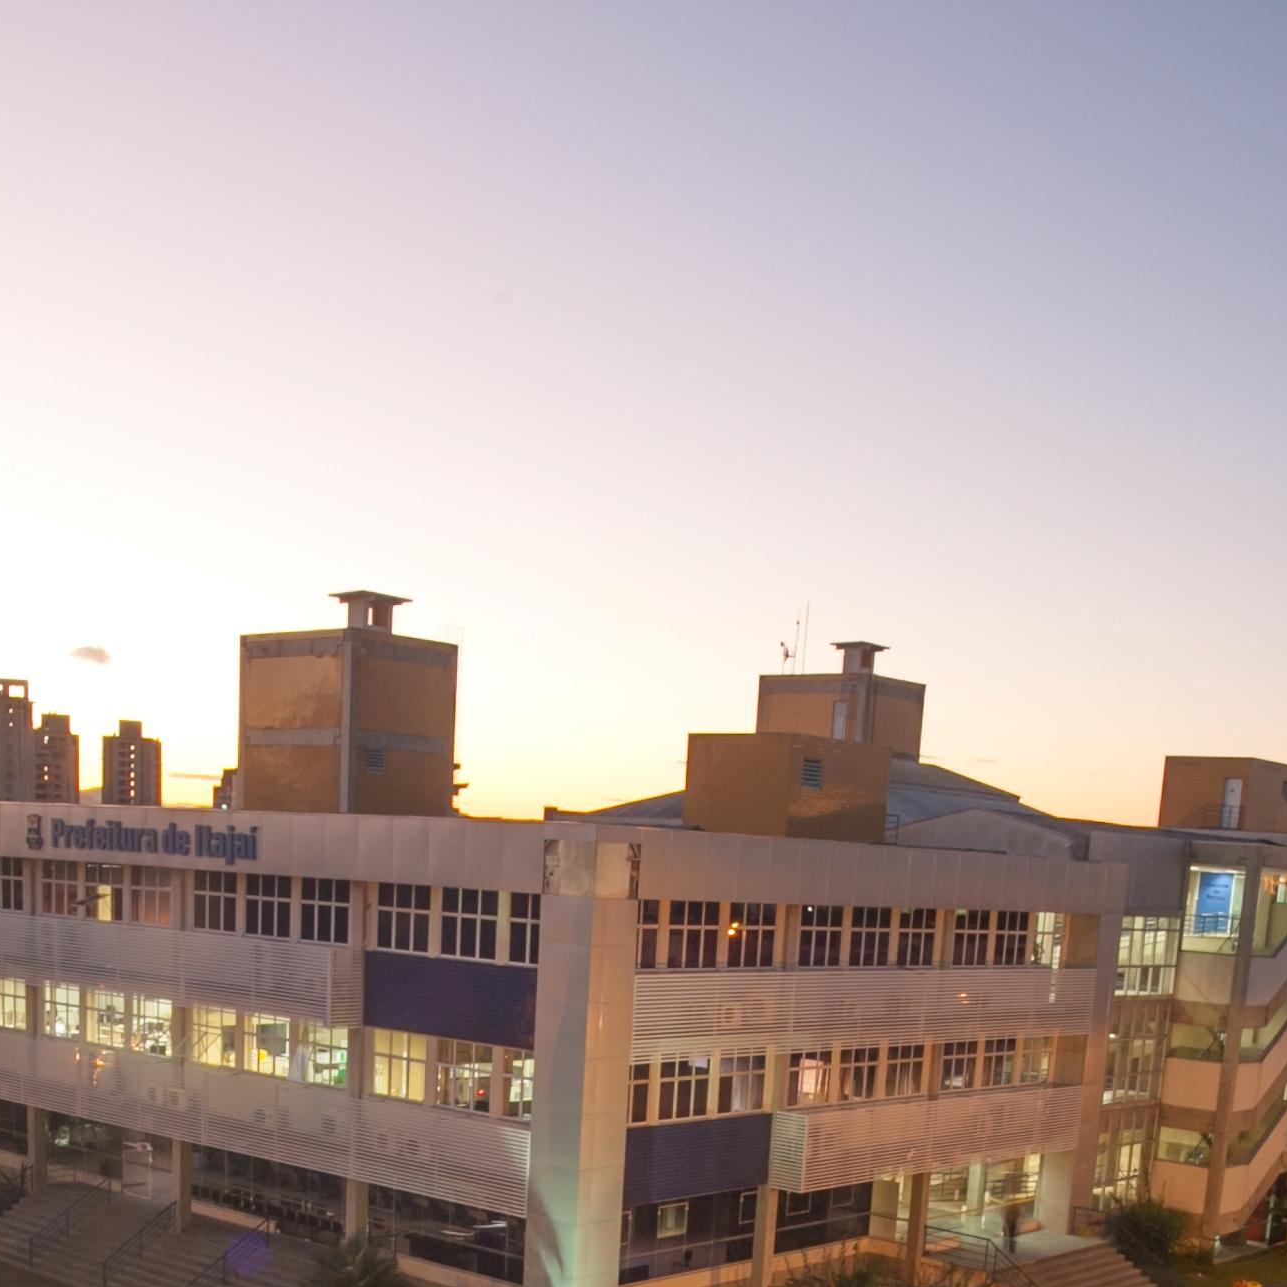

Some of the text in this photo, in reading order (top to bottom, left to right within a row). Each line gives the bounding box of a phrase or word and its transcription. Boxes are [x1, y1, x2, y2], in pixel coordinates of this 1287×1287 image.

[51, 818, 259, 866] Prefeitura de Itajaí
